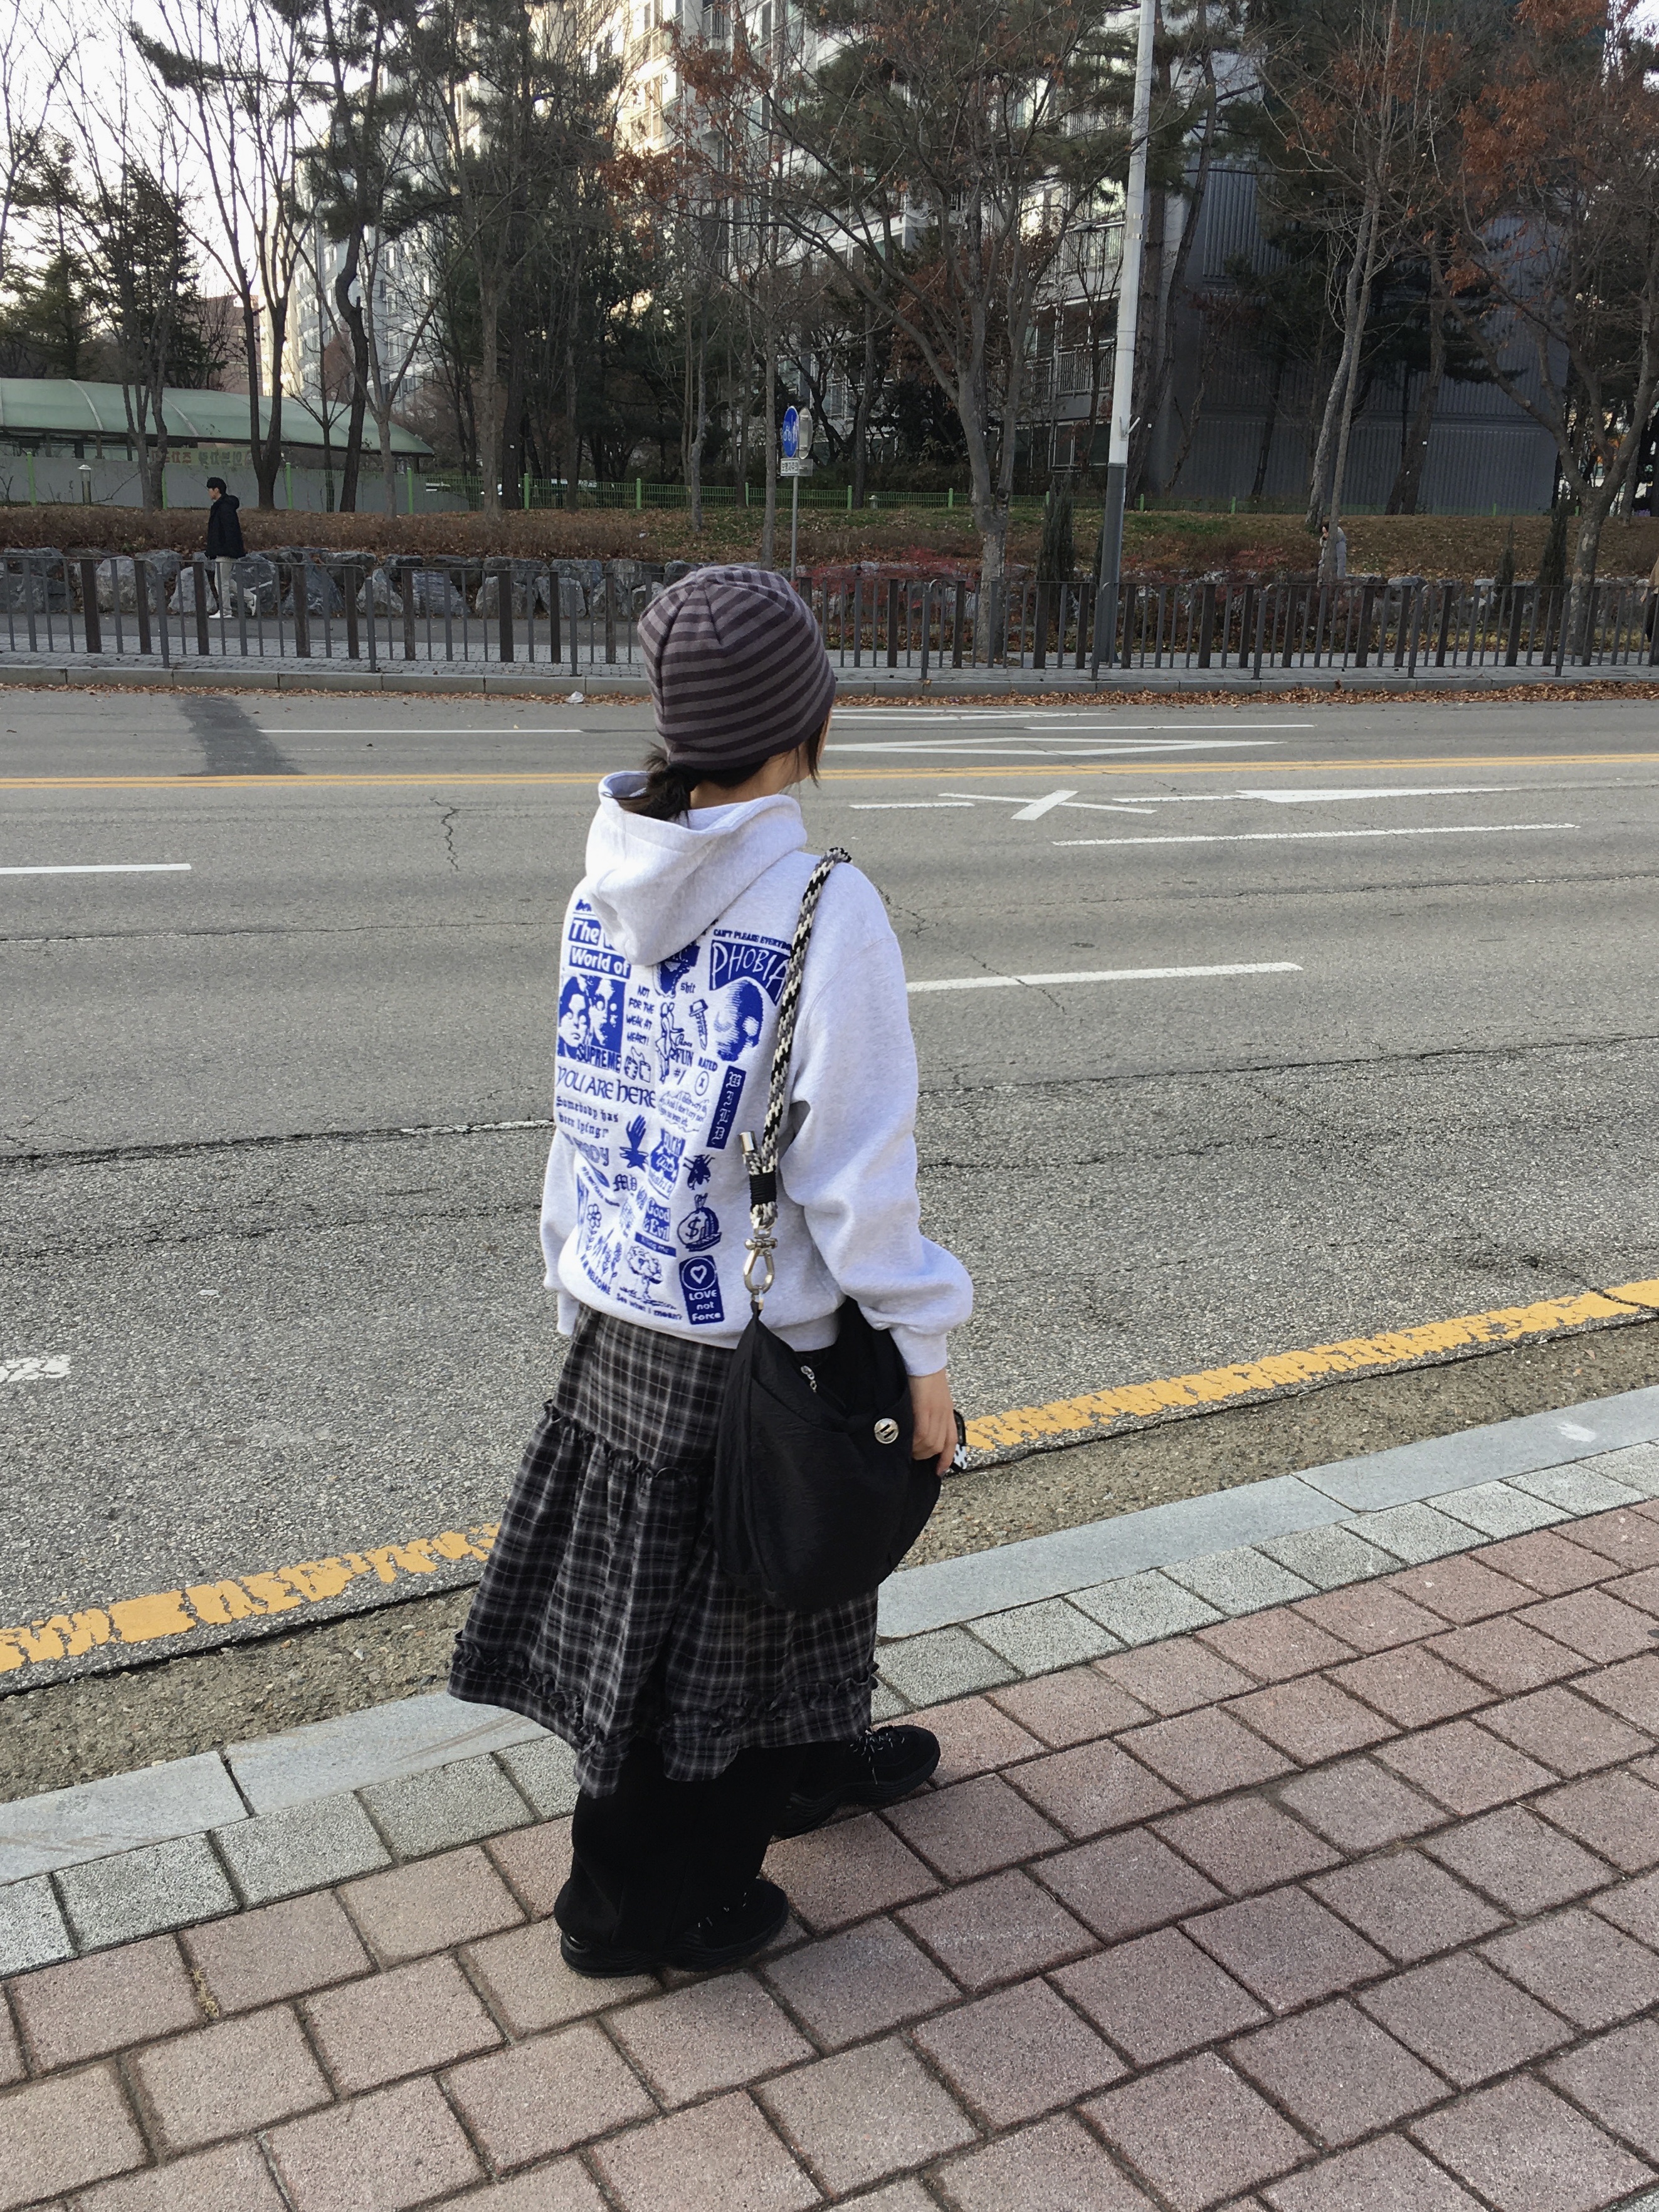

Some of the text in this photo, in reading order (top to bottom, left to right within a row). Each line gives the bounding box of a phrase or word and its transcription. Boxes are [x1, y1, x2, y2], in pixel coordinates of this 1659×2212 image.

[571, 919, 600, 944] The
[734, 931, 760, 942] PLEASE
[571, 947, 629, 977] World of
[712, 942, 789, 1002] PHOBIA
[637, 985, 650, 998] NOT
[628, 998, 655, 1014] FOR THE
[576, 1043, 621, 1073] SUPREME
[698, 1057, 718, 1072] RATED
[556, 1066, 586, 1092] YOU
[585, 1077, 614, 1100] ARE
[647, 1198, 670, 1223] Good
[650, 1218, 670, 1241] Evil
[688, 1289, 717, 1301] LOVE
[696, 1301, 715, 1310] not
[692, 1312, 721, 1322] Force
